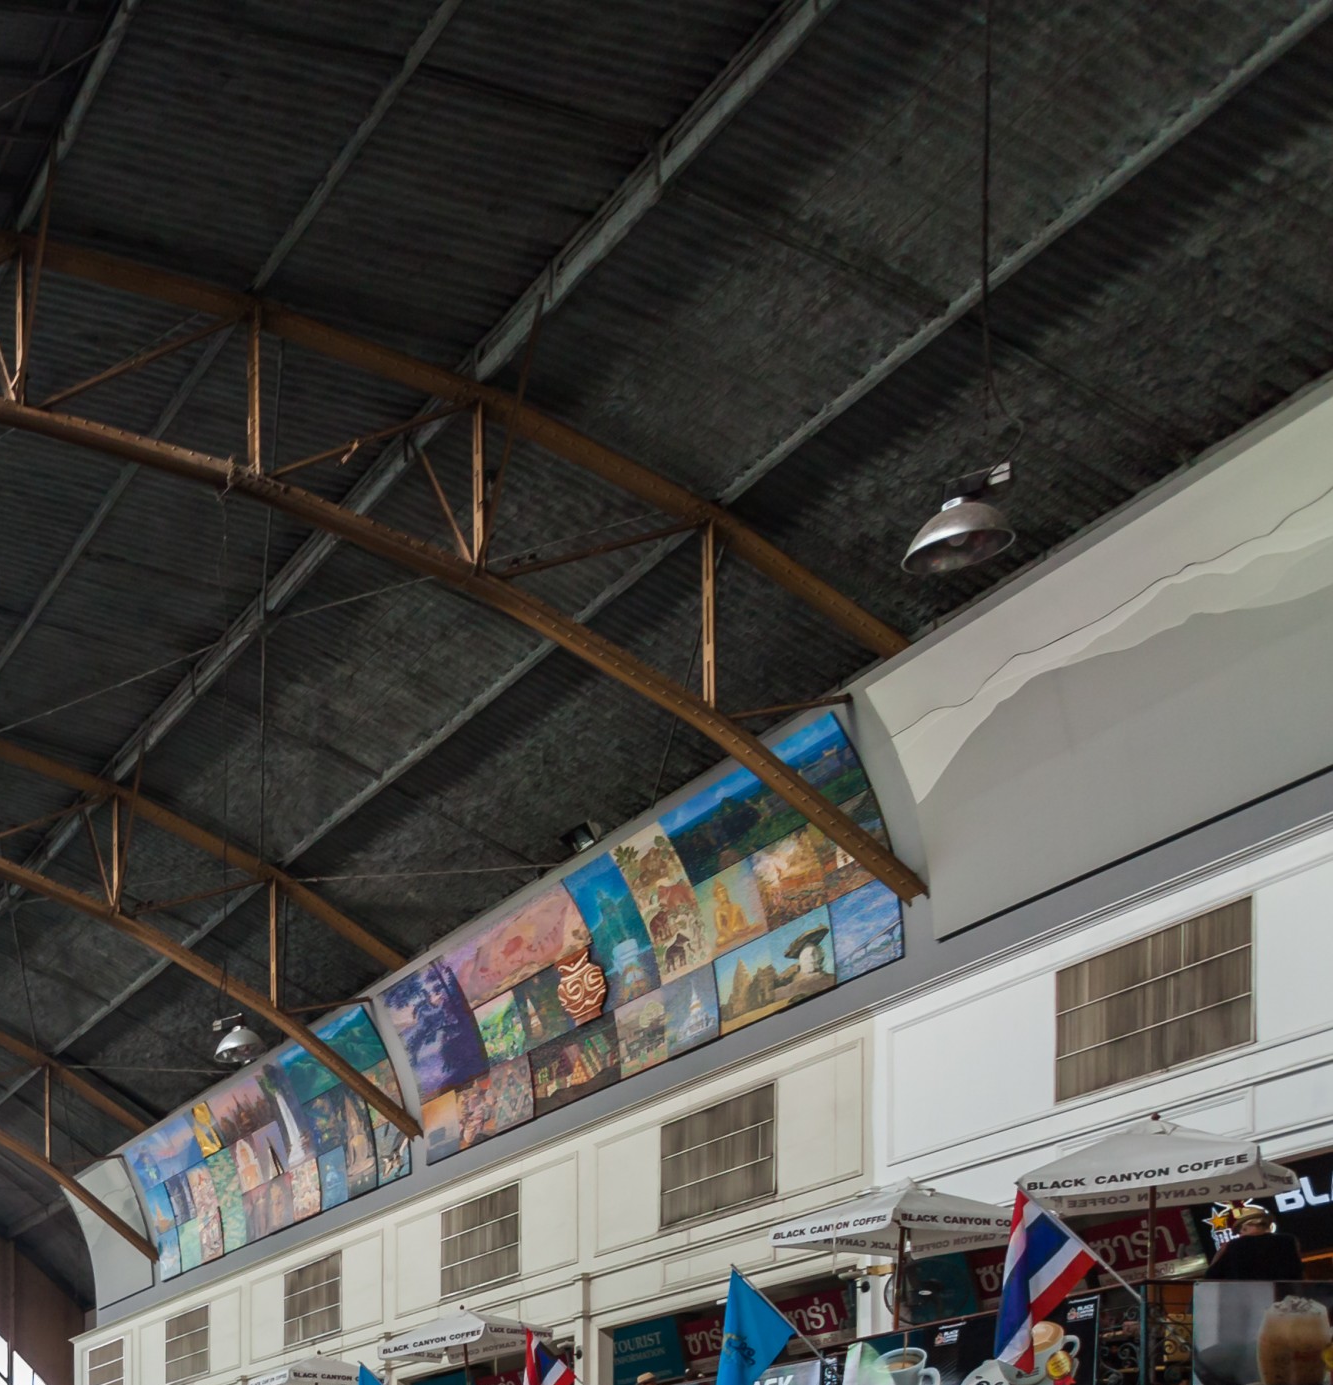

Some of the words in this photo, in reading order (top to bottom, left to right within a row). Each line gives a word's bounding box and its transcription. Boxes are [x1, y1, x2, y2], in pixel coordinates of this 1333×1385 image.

[1027, 1176, 1085, 1191] BLACK
[1094, 1168, 1170, 1185] CANYON
[1177, 1154, 1248, 1173] COFFEE
[773, 1228, 805, 1240] BLACK
[810, 1221, 850, 1234] CANYON
[852, 1214, 887, 1227] COFFEE
[901, 1212, 938, 1223] BLACK
[943, 1215, 991, 1226] CANYON
[383, 1344, 409, 1355] BLACK
[413, 1336, 446, 1348] CANYON
[449, 1329, 481, 1340] COFFEE
[293, 1371, 317, 1379] BLACK
[321, 1373, 352, 1381] CANYON
